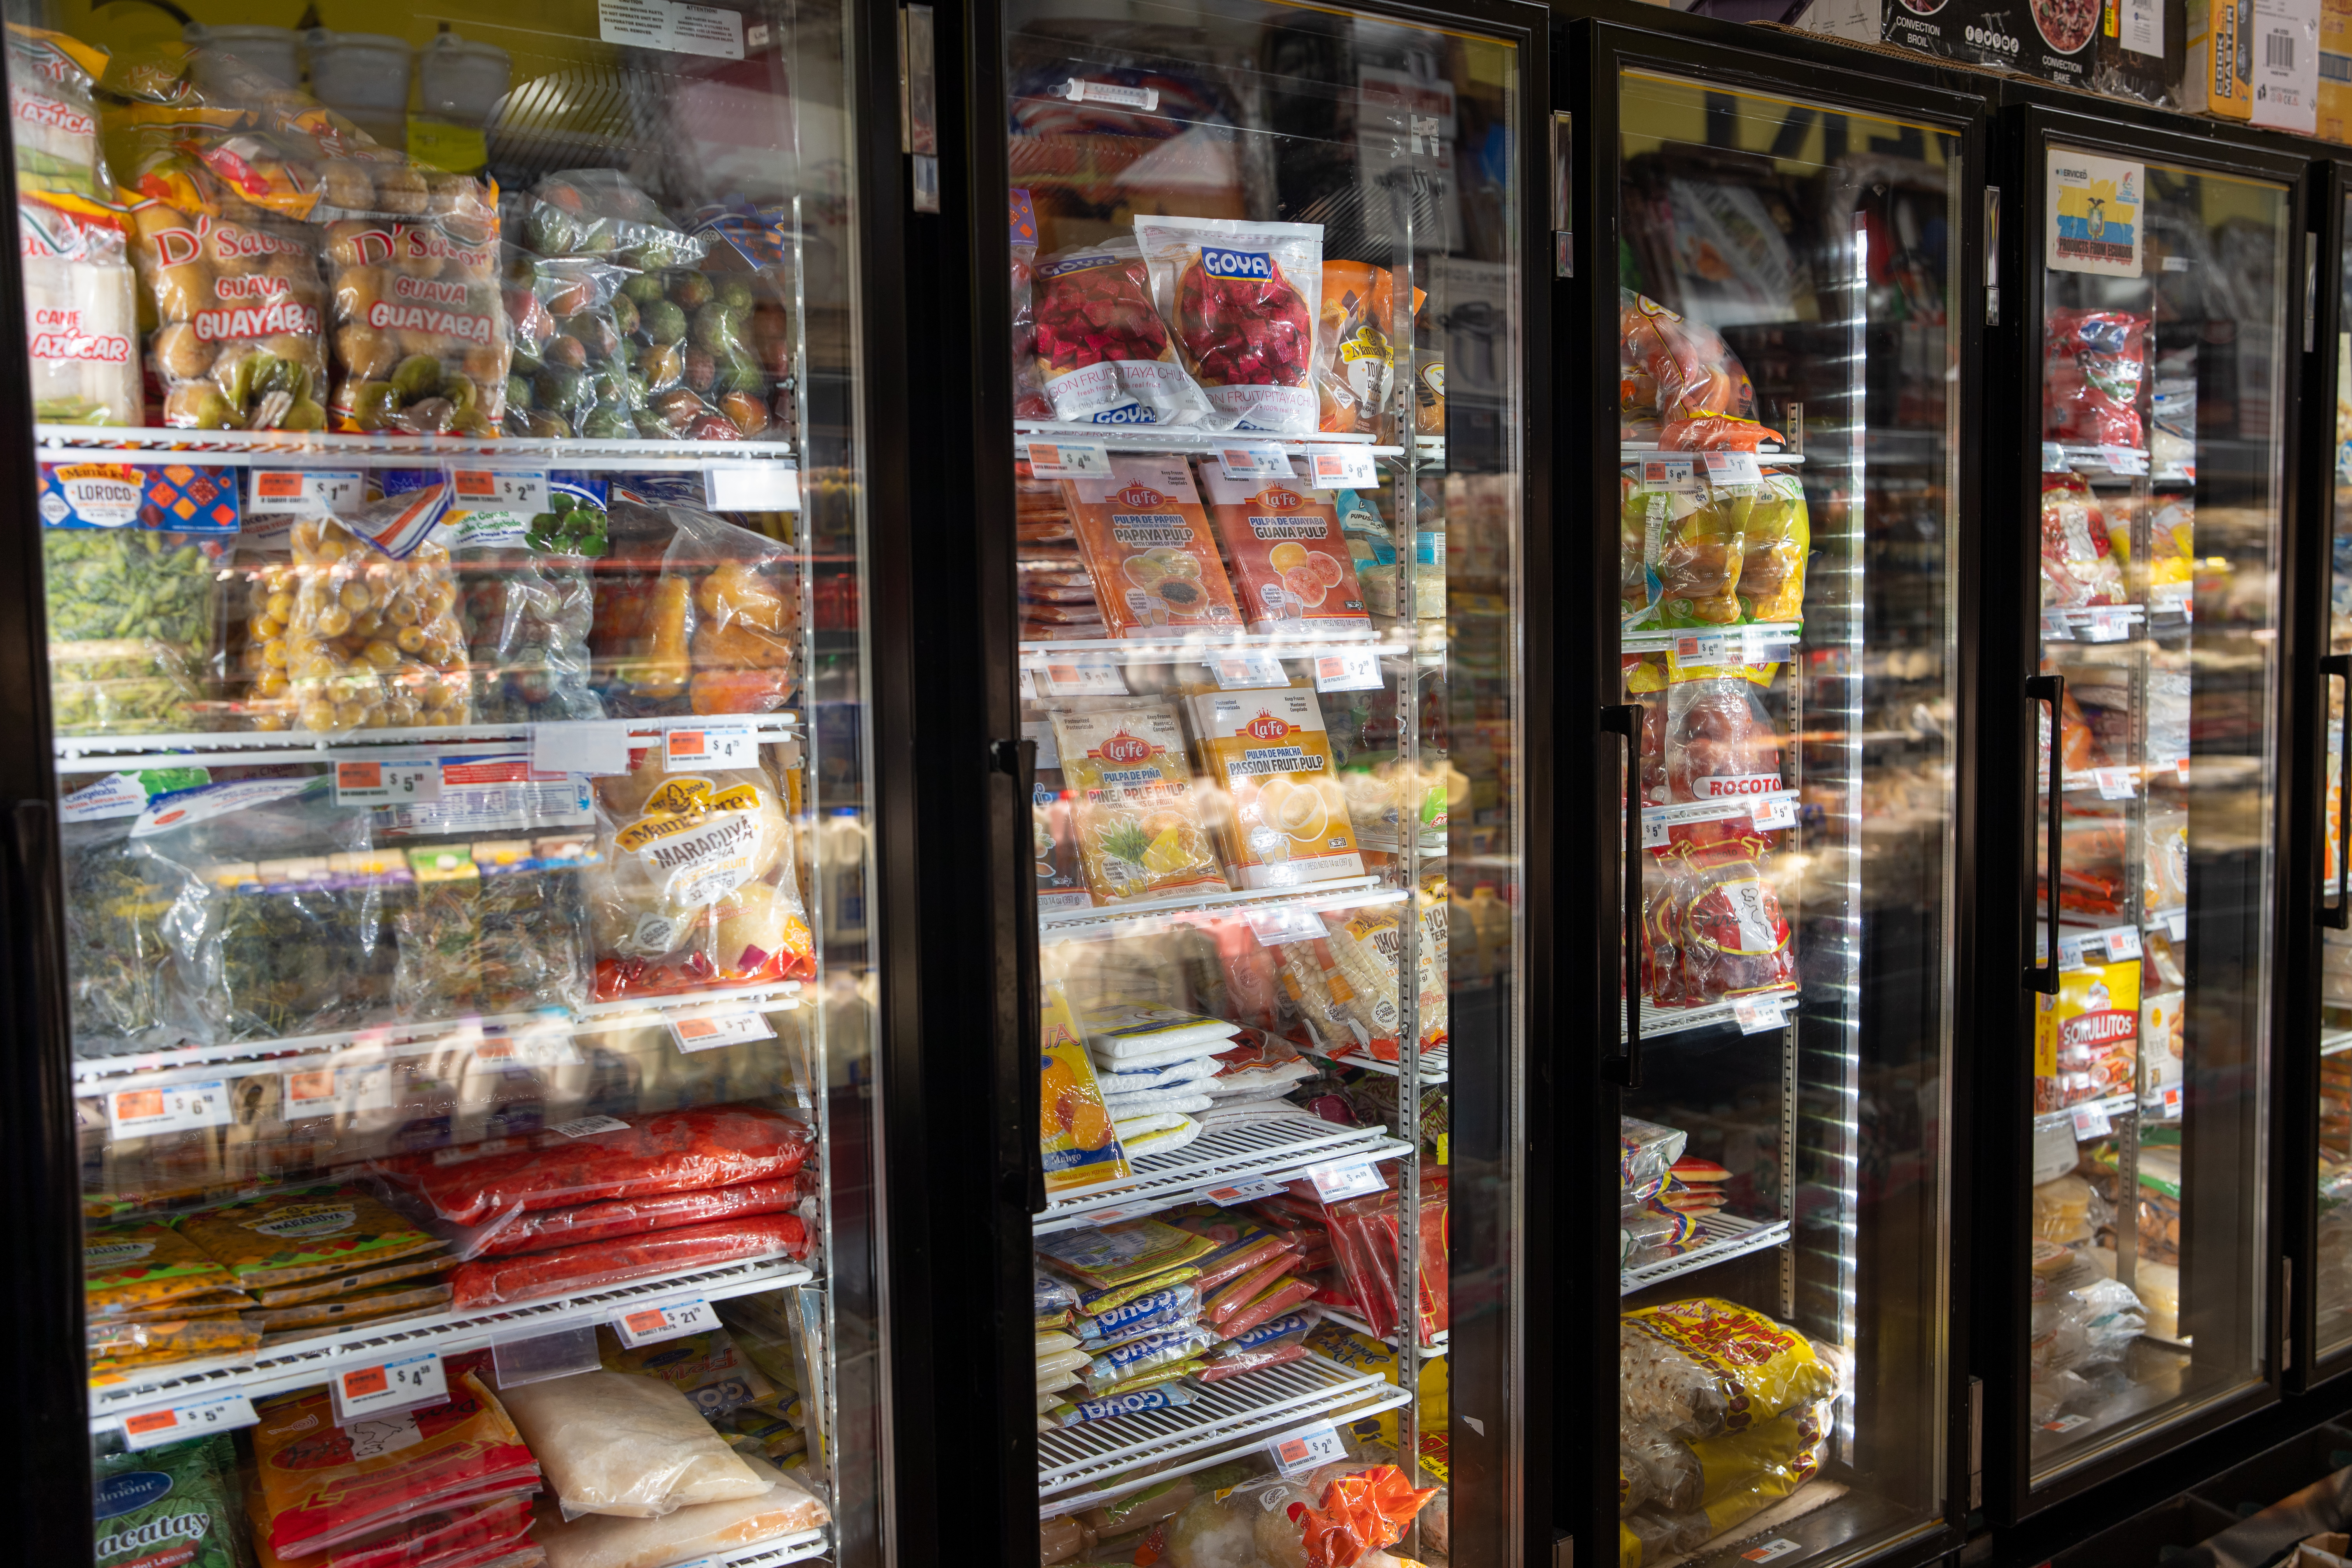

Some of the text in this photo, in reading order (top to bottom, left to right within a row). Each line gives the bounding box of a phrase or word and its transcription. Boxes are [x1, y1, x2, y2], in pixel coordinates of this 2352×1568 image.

[686, 5, 718, 14] ATTENTION!
[604, 18, 662, 30] EVAPORATOR ENCLOSURE
[1896, 16, 1940, 36] CONVECTION
[1908, 33, 1928, 47] BROIL
[2225, 5, 2233, 98] MASTER
[2042, 55, 2082, 74] CONVECTION
[2053, 72, 2070, 84] BAKE
[2060, 238, 2133, 259] PRODUCTS FROM ECUADOR
[1040, 256, 1116, 276] GOYA
[1203, 251, 1269, 276] GOYA
[216, 274, 292, 300] GUAVA
[397, 276, 466, 304] GUAVA
[37, 310, 81, 326] CANE
[194, 302, 320, 341] GUAYABA
[369, 301, 492, 344] GUAYABA
[33, 328, 130, 362] AZÚCAR
[1351, 344, 1379, 358] Mama
[1078, 388, 1094, 397] fresh
[1096, 407, 1155, 424] GOYA
[1349, 464, 1353, 473] $
[1730, 459, 1735, 467] $
[1670, 469, 1674, 478] $
[78, 485, 131, 501] LOROCO
[317, 481, 324, 493] $
[504, 482, 512, 495] $
[1695, 494, 1707, 502] de
[1113, 515, 1141, 524] PULPA
[1153, 516, 1185, 524] PAPAYA
[1250, 517, 1276, 525] PULPA
[1289, 517, 1326, 525] GUAYABA
[1115, 529, 1194, 541] PAPAYA PULP
[1255, 527, 1327, 538] GUAVA PULP
[1171, 628, 1180, 636] NET
[1702, 643, 1706, 652] $
[1350, 662, 1355, 671] $
[714, 740, 719, 752] $
[1246, 747, 1302, 760] PULPA DE PARCHA
[1229, 755, 1323, 776] PASSION FRUIT PULP
[1104, 768, 1161, 782] PULPA DE PIÑA
[686, 782, 705, 796] 2004
[1088, 783, 1185, 804] PINEAPPLE PULP
[1710, 778, 1782, 796] ROCOTO
[1774, 806, 1778, 815] $
[1646, 825, 1650, 834] $
[653, 814, 754, 869] MARACUYÁ
[1706, 848, 1738, 861] Rocoto
[716, 856, 747, 873] FRUIT
[1307, 862, 1318, 870] PESO
[1318, 861, 1329, 869] NETO
[1049, 896, 1055, 905] 14
[1375, 1005, 1394, 1015] CALIDAD
[1377, 1009, 1396, 1020] SUPERIOR
[2063, 1014, 2133, 1045] SORULLITOS
[1051, 1153, 1082, 1164] Mango
[1220, 1237, 1253, 1255] Guayaba
[667, 1312, 675, 1321] $
[398, 1369, 406, 1383] $
[1083, 1393, 1164, 1418] GOYA
[1312, 1442, 1319, 1452] $
[154, 1550, 194, 1566] Leaves
